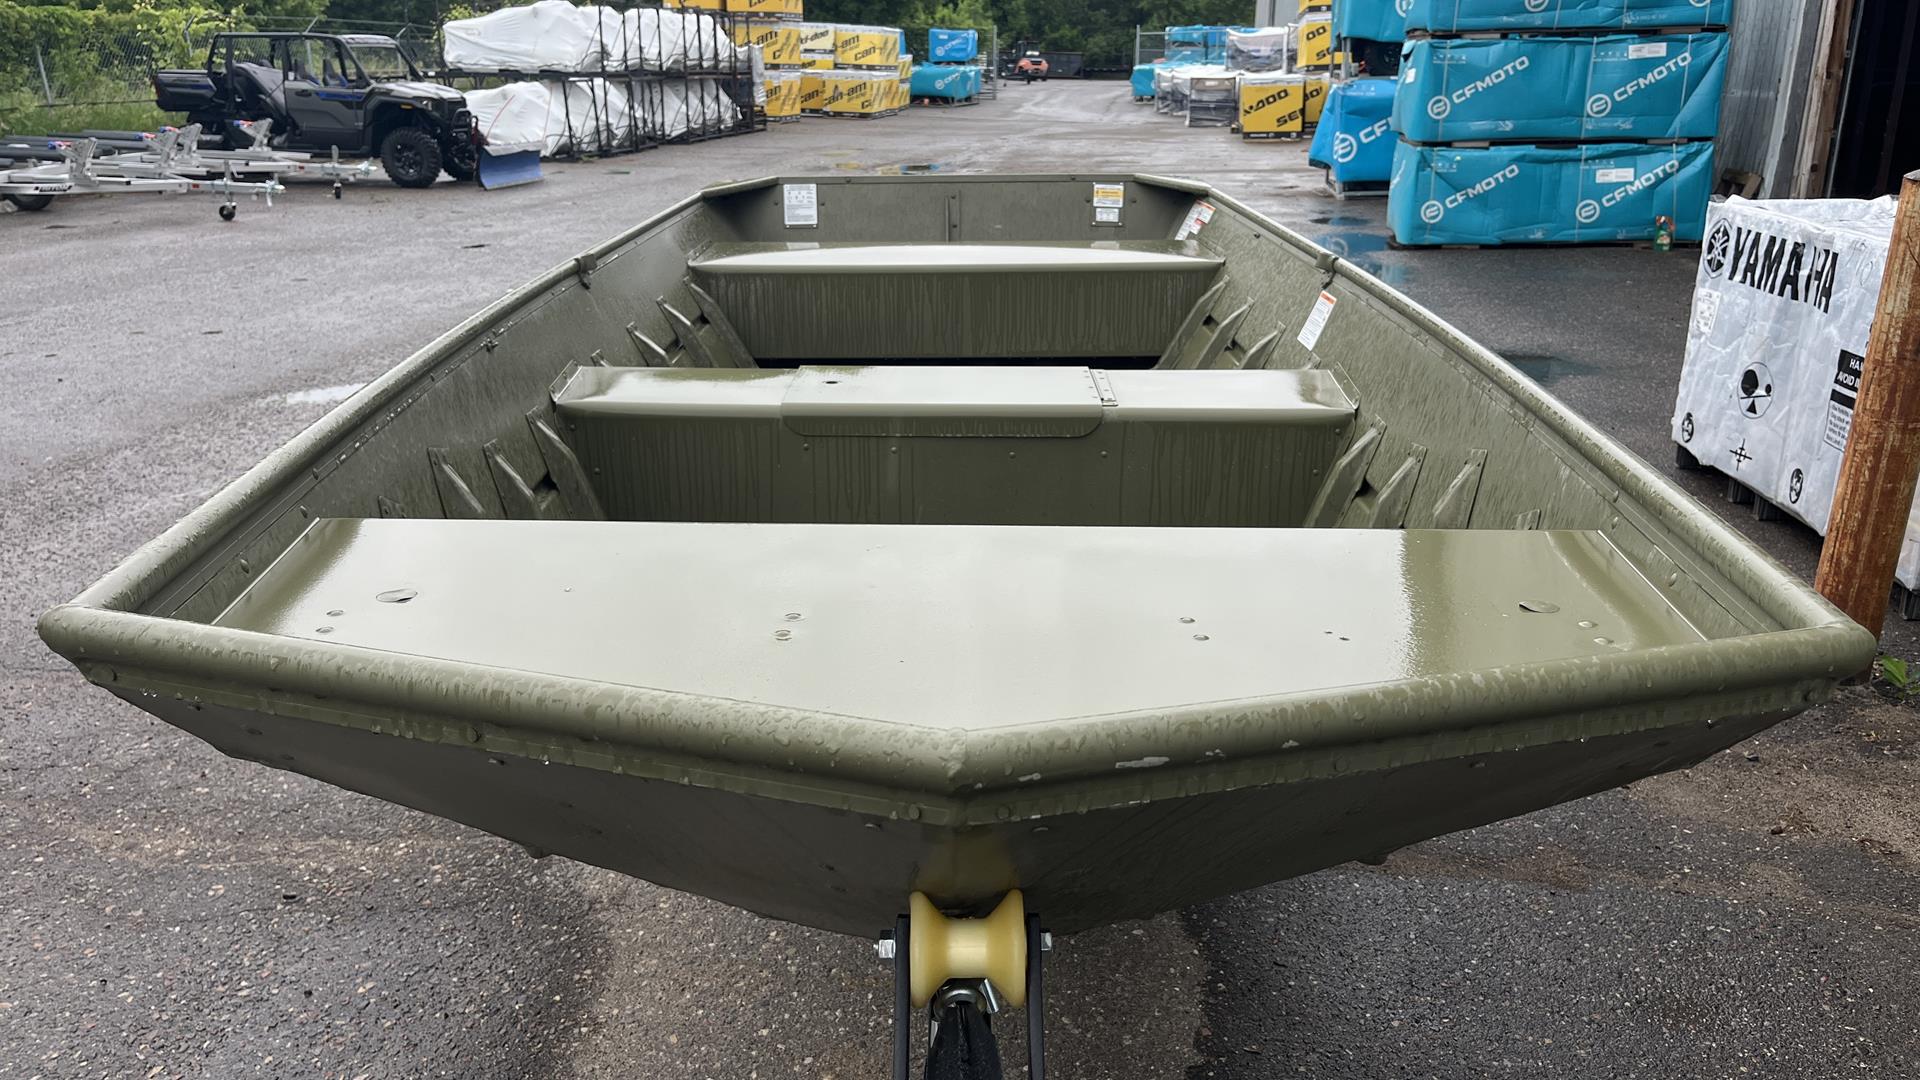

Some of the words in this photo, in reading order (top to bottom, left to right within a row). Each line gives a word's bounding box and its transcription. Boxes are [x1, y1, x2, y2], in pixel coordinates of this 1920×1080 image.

[1452, 55, 1529, 104] CFMOTO
[1613, 52, 1692, 102] CFMOTO
[1445, 164, 1519, 209] CFMOTO
[1601, 159, 1680, 208] CFMOTO
[1728, 226, 1839, 314] YAMAHA
